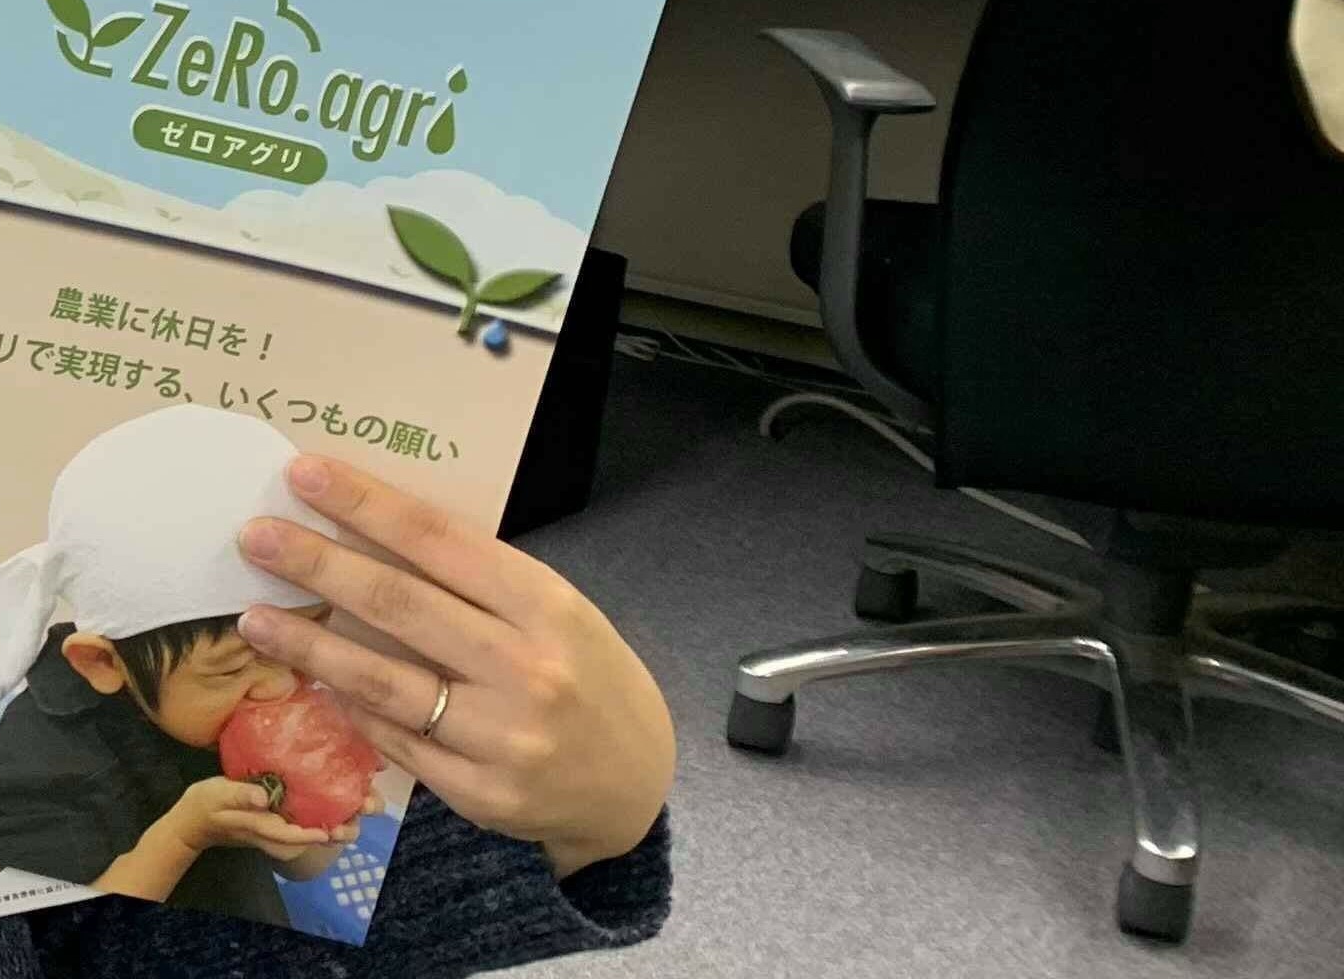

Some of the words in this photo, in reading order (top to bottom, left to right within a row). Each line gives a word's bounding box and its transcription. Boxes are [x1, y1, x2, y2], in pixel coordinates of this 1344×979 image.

[159, 121, 304, 176] ゼロアグリ
[48, 286, 273, 362] 農業に休日を！
